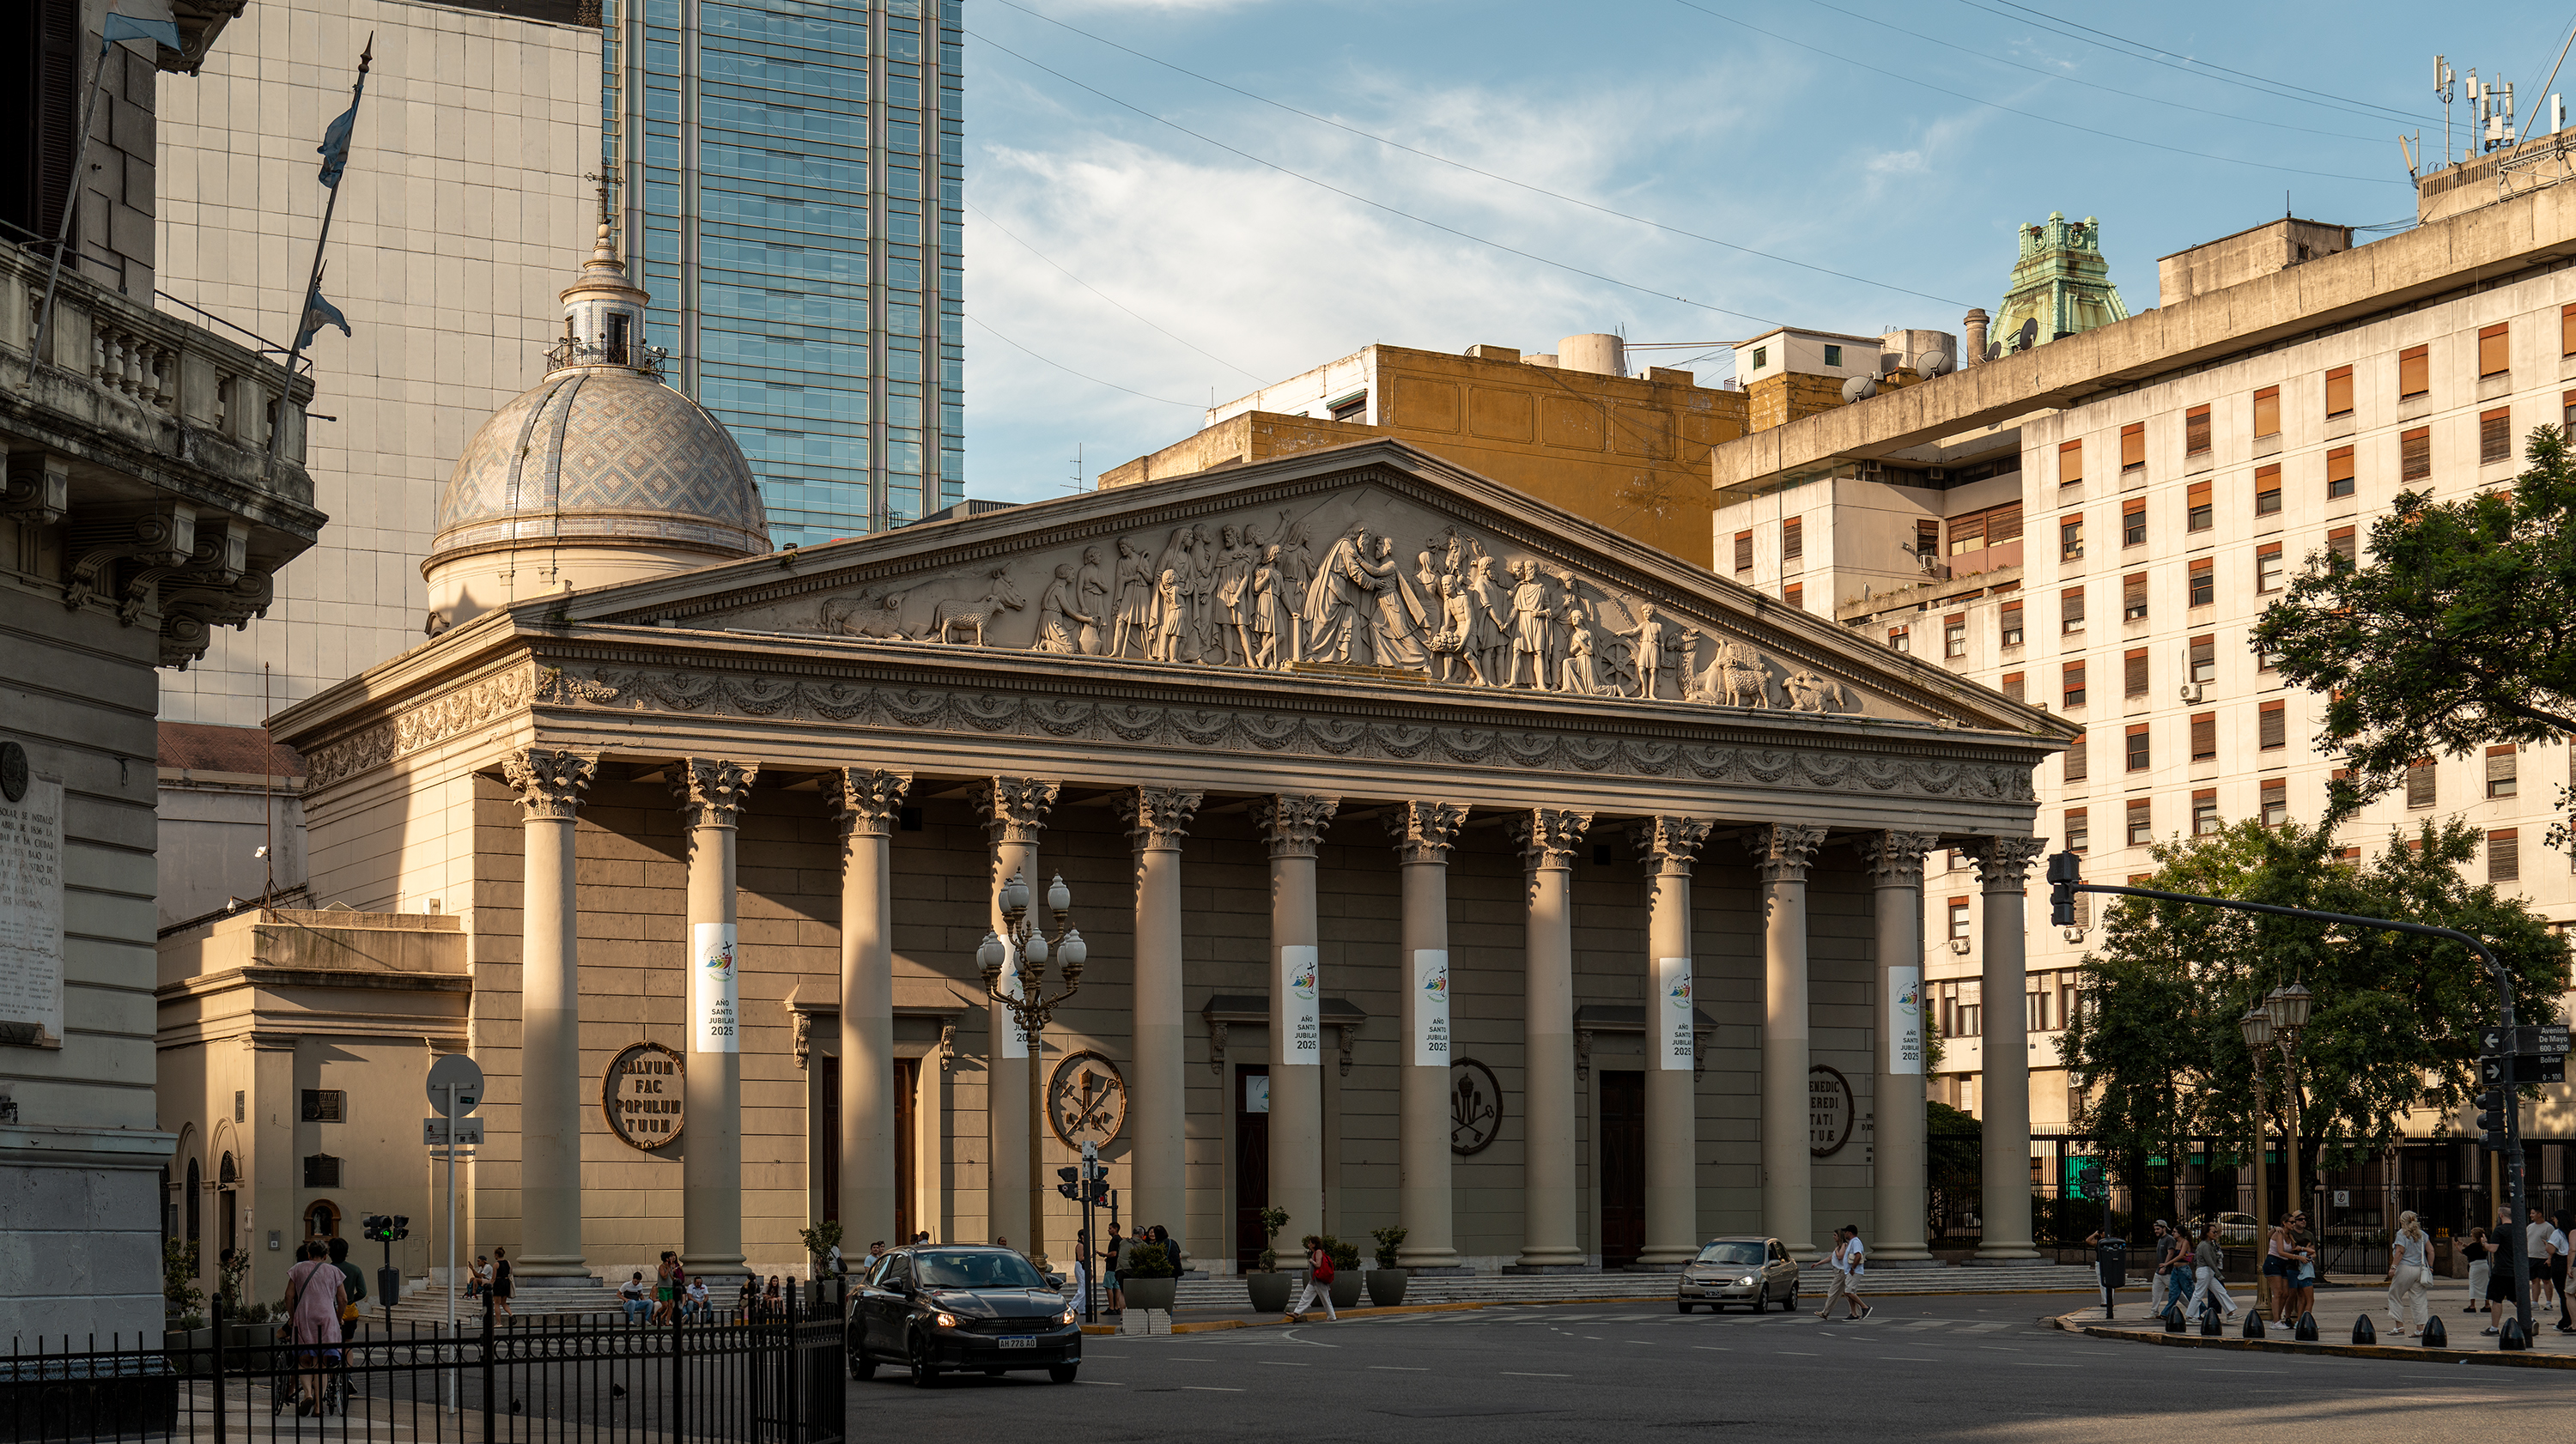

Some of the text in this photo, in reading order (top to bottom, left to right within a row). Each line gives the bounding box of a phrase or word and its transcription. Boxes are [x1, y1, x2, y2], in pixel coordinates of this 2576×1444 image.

[711, 1026, 734, 1035] 2025
[1297, 1041, 1316, 1049] 2025
[1428, 1042, 1447, 1051] 2025
[1674, 1047, 1692, 1055] 2025
[620, 1061, 673, 1075] SALVUM
[635, 1079, 662, 1093] FAC
[1809, 1081, 1839, 1092] ENEDIC
[615, 1100, 681, 1113] POPULUM
[1811, 1097, 1838, 1109] EREDI
[1810, 1114, 1833, 1125] TATI
[626, 1119, 670, 1133] TUUM
